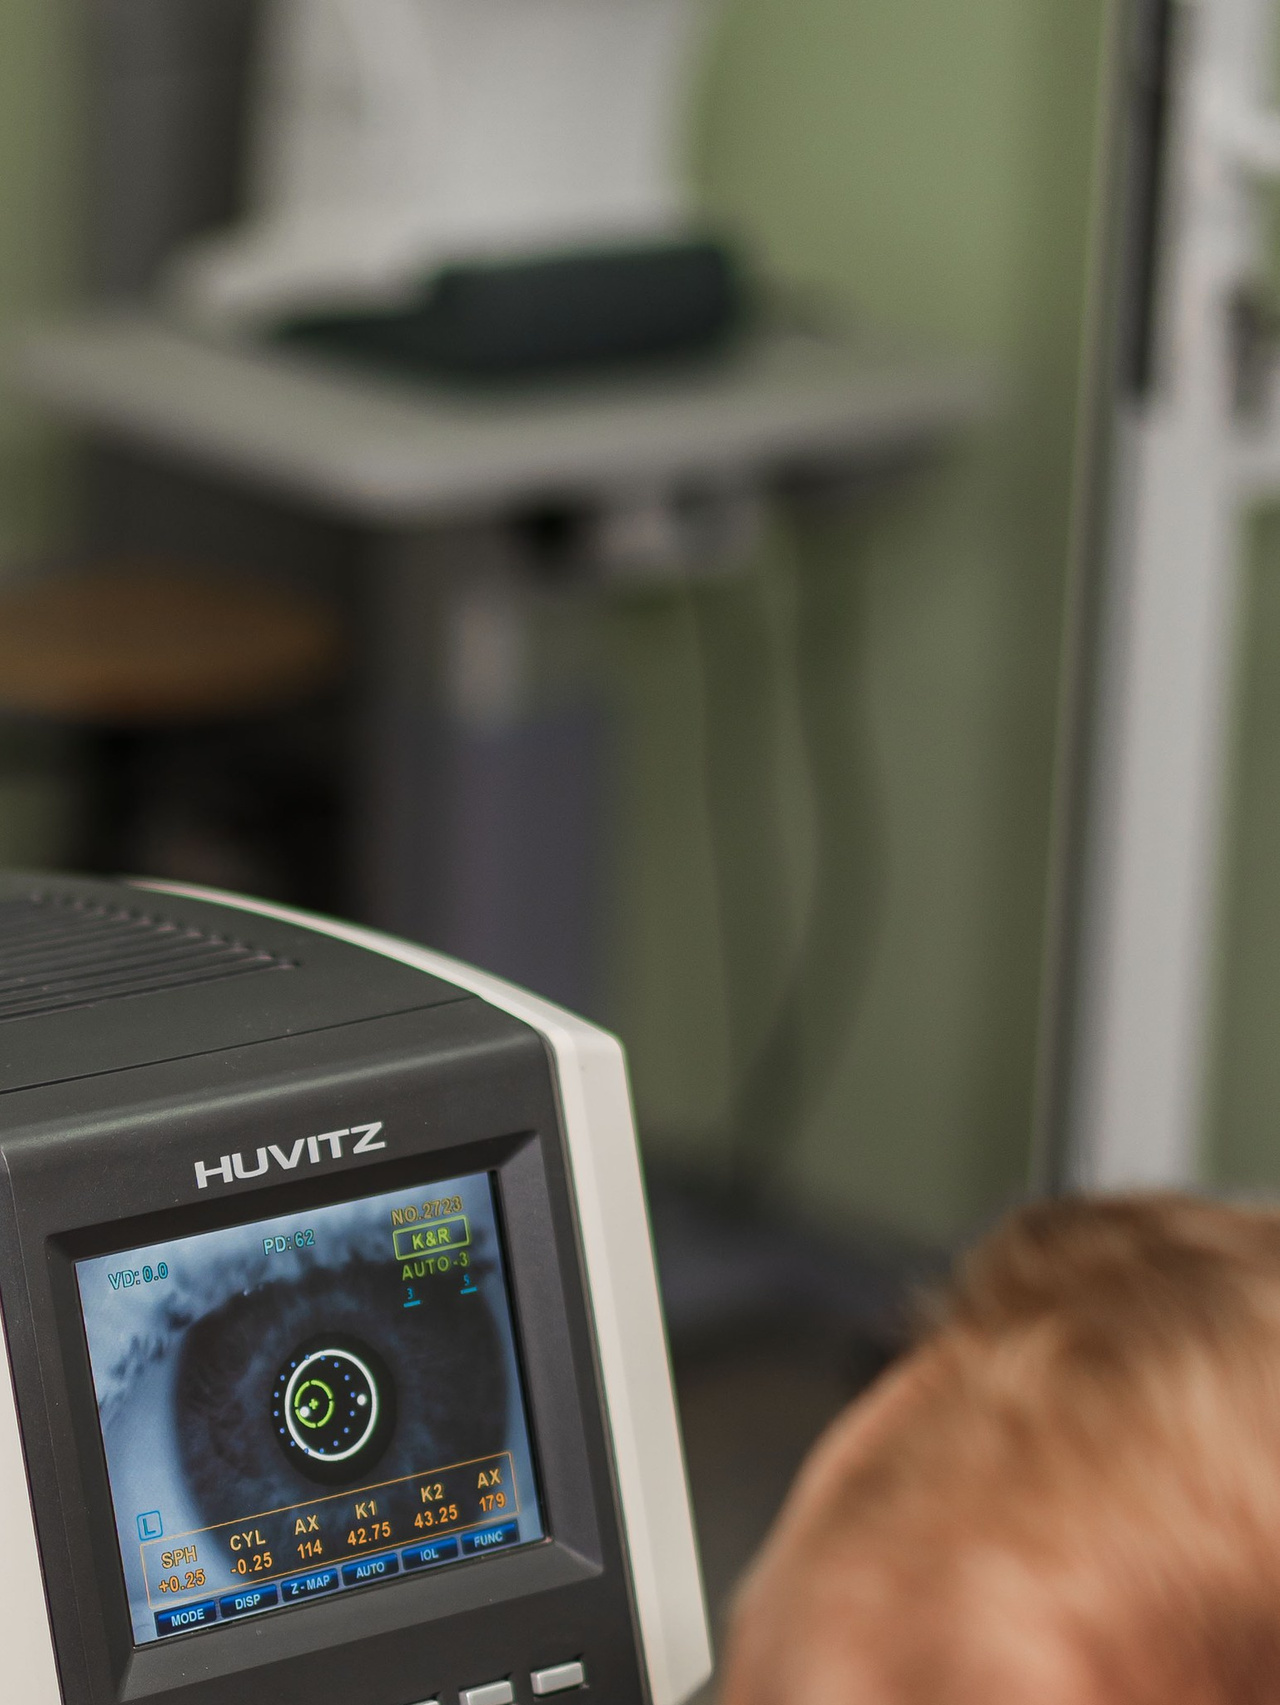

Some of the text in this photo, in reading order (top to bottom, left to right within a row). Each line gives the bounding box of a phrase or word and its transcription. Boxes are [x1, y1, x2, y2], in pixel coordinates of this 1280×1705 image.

[194, 1121, 386, 1189] HUVITZ
[391, 1195, 463, 1226] NO.2723
[412, 1227, 451, 1250] K&R
[142, 1518, 157, 1536] L
[161, 1468, 502, 1569] SPH CYL AX K1 K2 AX
[158, 1492, 506, 1593] +0.25 -0.25 114 42.75 43.25 179
[474, 1531, 504, 1547] FUNC
[421, 1548, 439, 1562] IOL
[356, 1561, 385, 1579] AUTO
[235, 1594, 261, 1610] DISP
[171, 1608, 205, 1627] MODE
